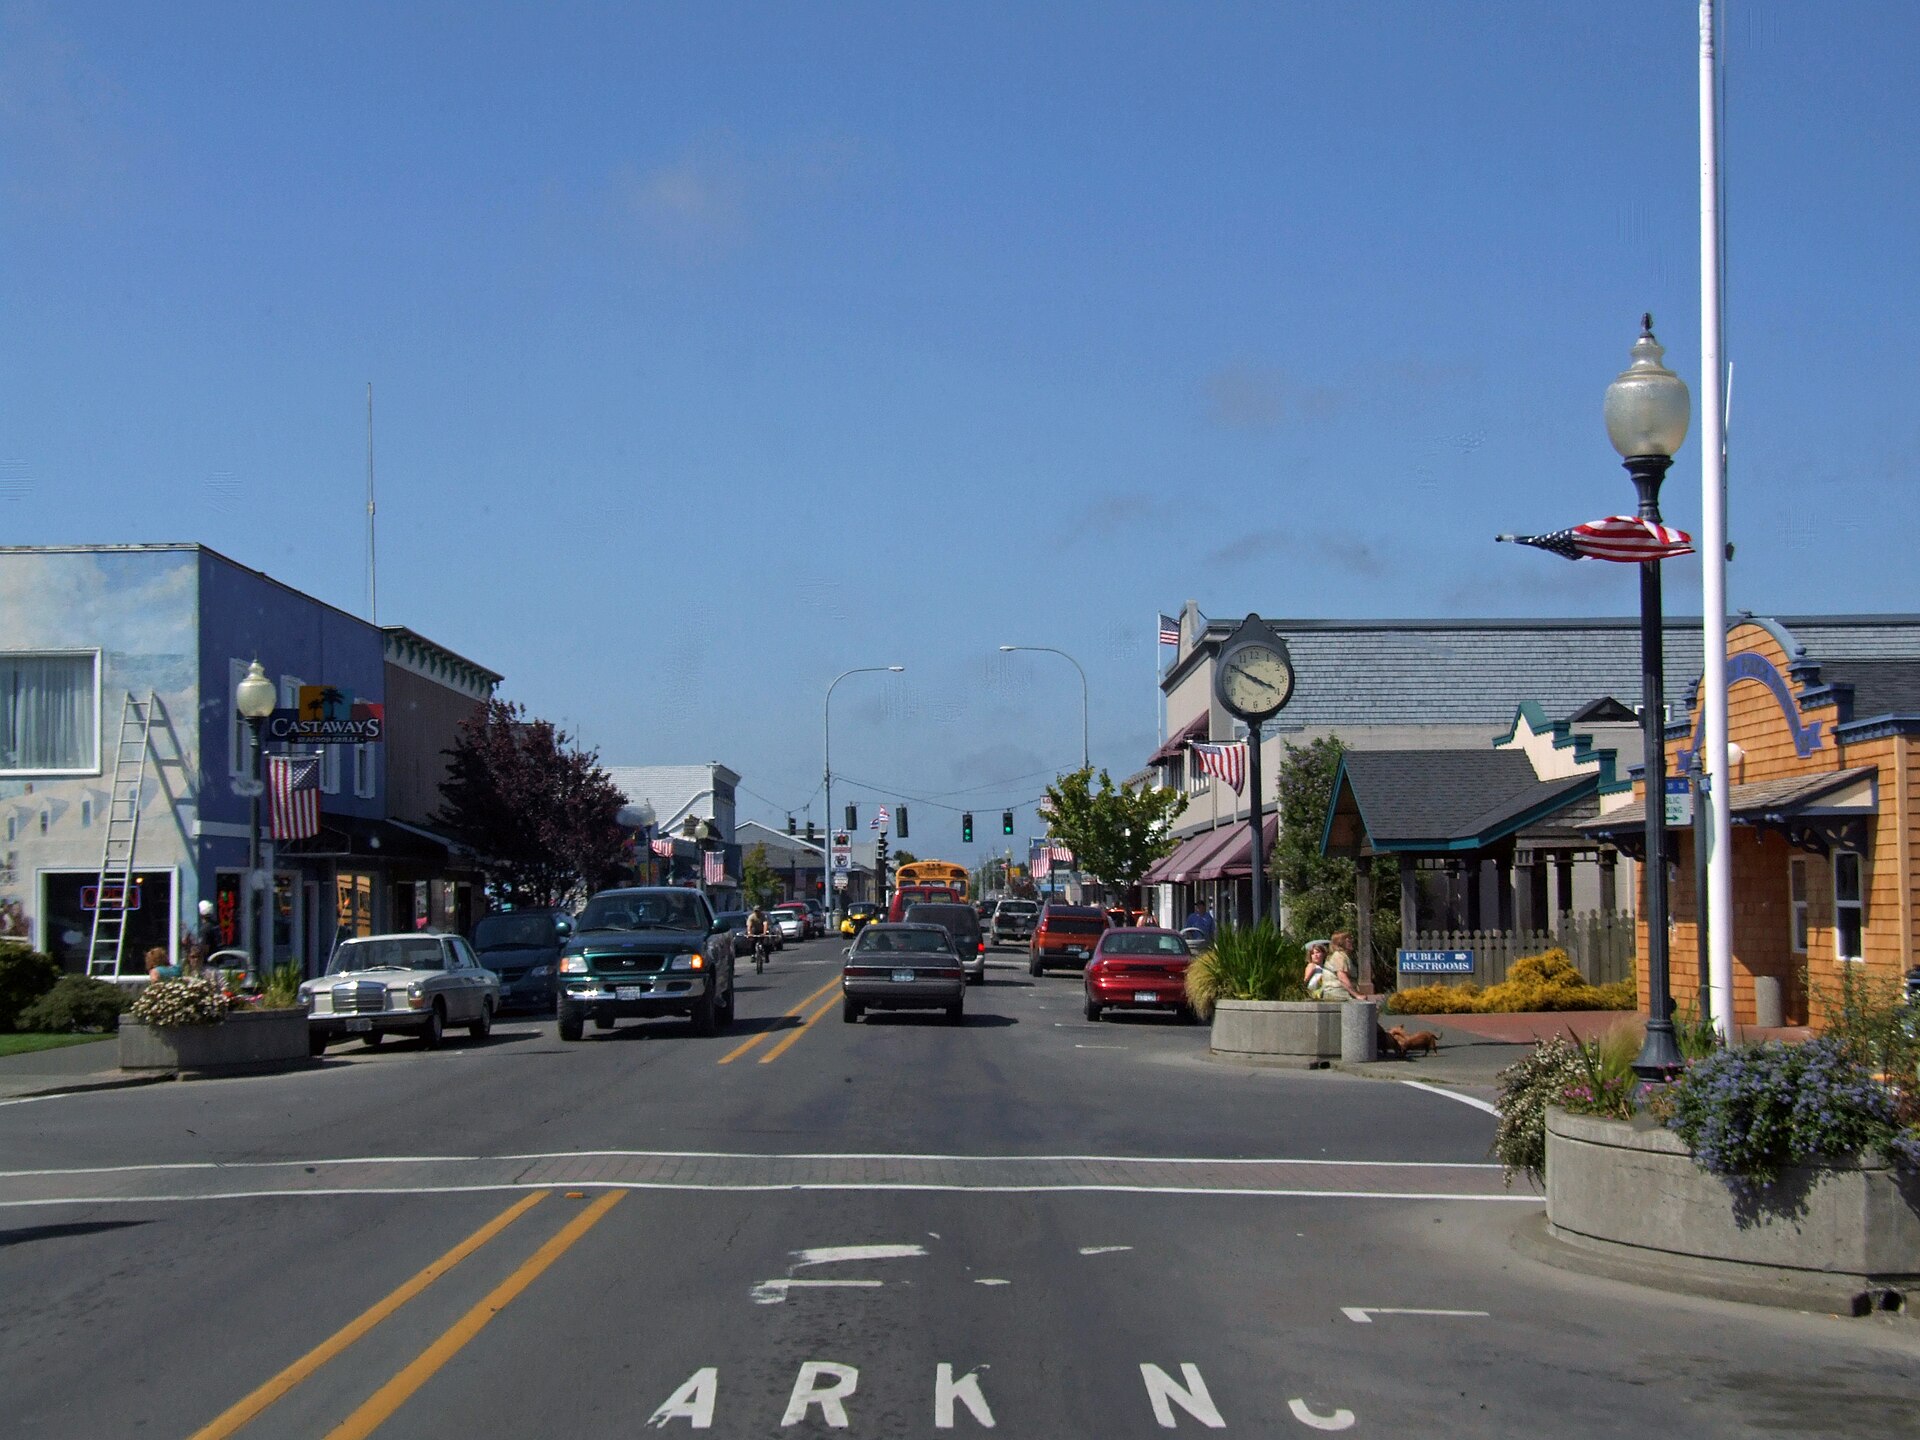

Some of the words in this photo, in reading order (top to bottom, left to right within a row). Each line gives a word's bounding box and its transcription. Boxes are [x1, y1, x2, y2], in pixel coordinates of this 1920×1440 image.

[1239, 654, 1247, 664] 11
[1250, 650, 1260, 660] 12
[1274, 662, 1281, 672] 2
[1279, 674, 1286, 684] 3
[271, 717, 379, 737] CASTAWAYS
[1405, 952, 1445, 961] PUBLIC
[1402, 962, 1469, 970] RESTROOMS
